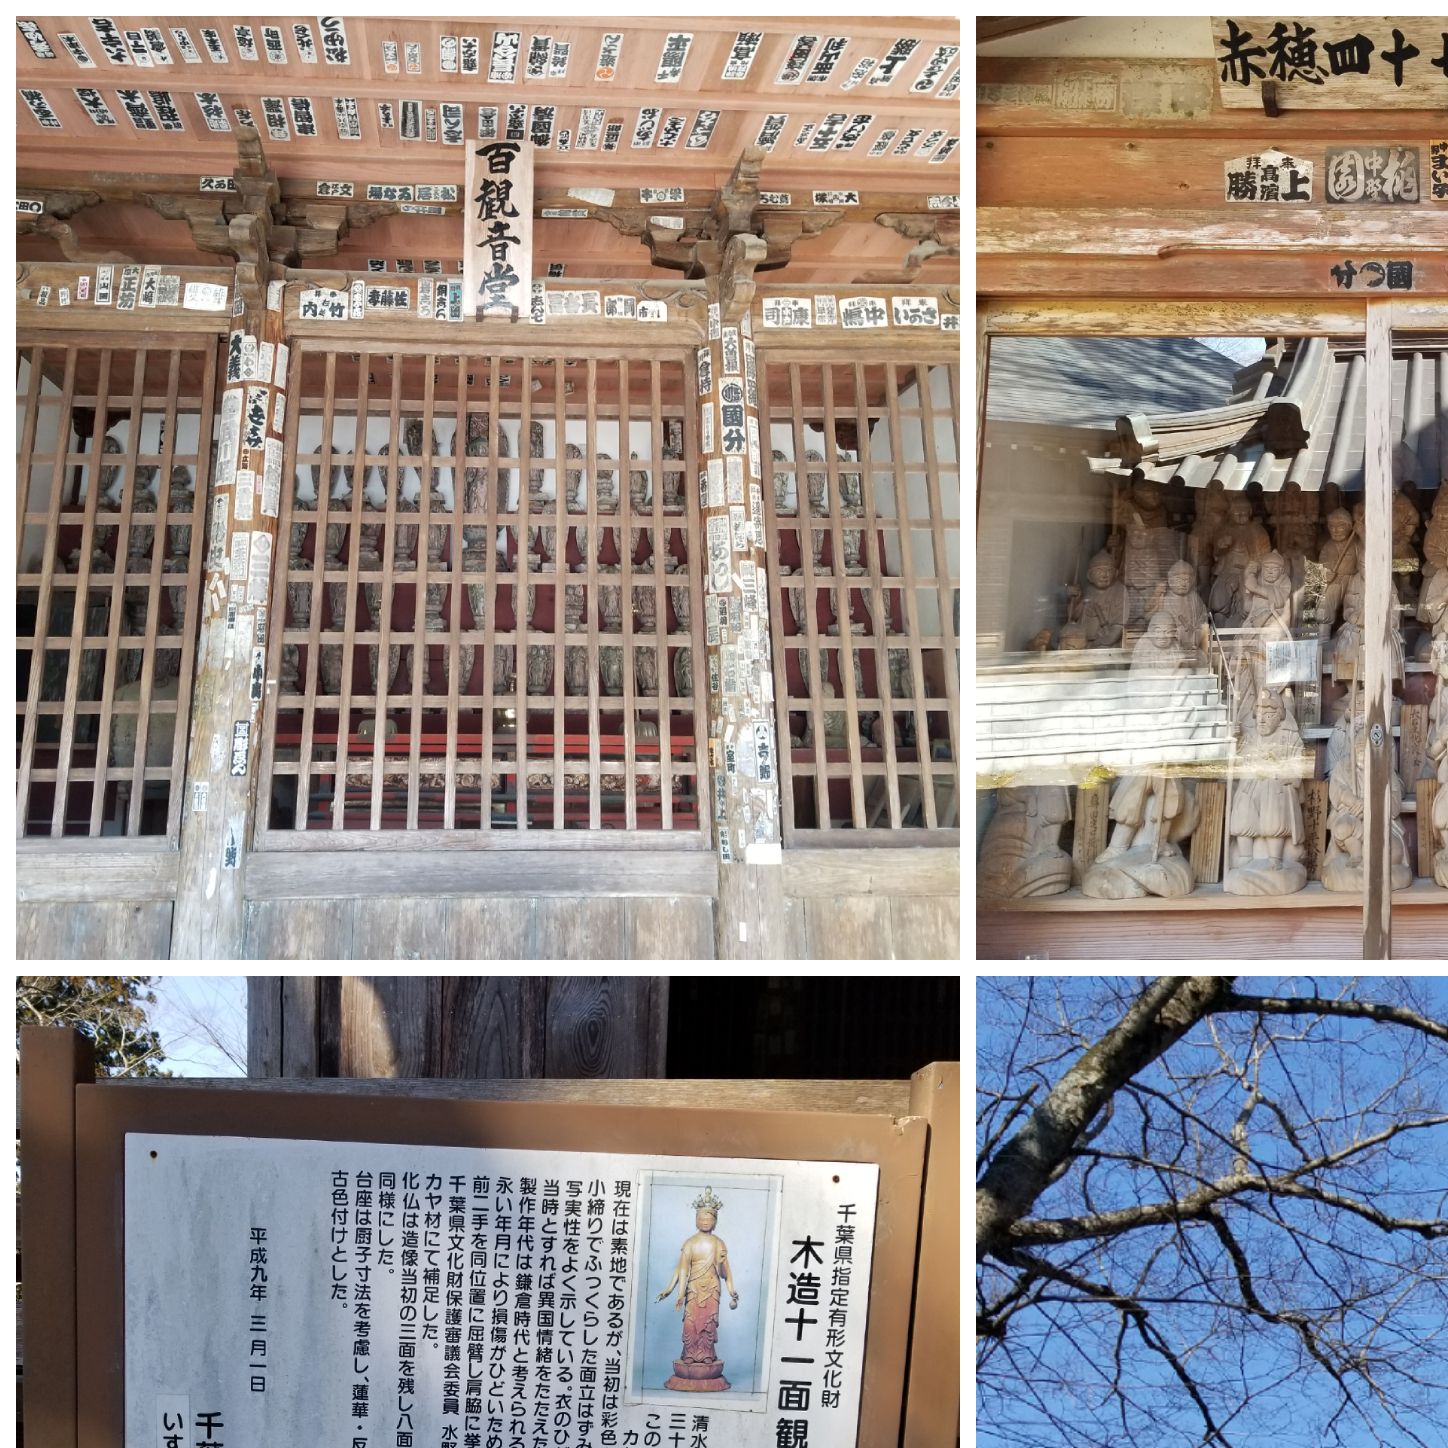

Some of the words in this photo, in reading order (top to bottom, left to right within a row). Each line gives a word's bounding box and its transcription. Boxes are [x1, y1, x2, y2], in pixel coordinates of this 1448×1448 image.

[475, 142, 521, 311] 百観音堂
[1227, 169, 1311, 202] 上勝
[330, 1170, 350, 1310] 古色付けとした。
[377, 1172, 397, 1277] 同様にした。
[421, 1173, 443, 1351] カヤ材にて補足した。
[442, 1176, 468, 1415] 千葉県文化財保護審議会委員
[821, 1203, 858, 1409] 千葉県指定有形文化財
